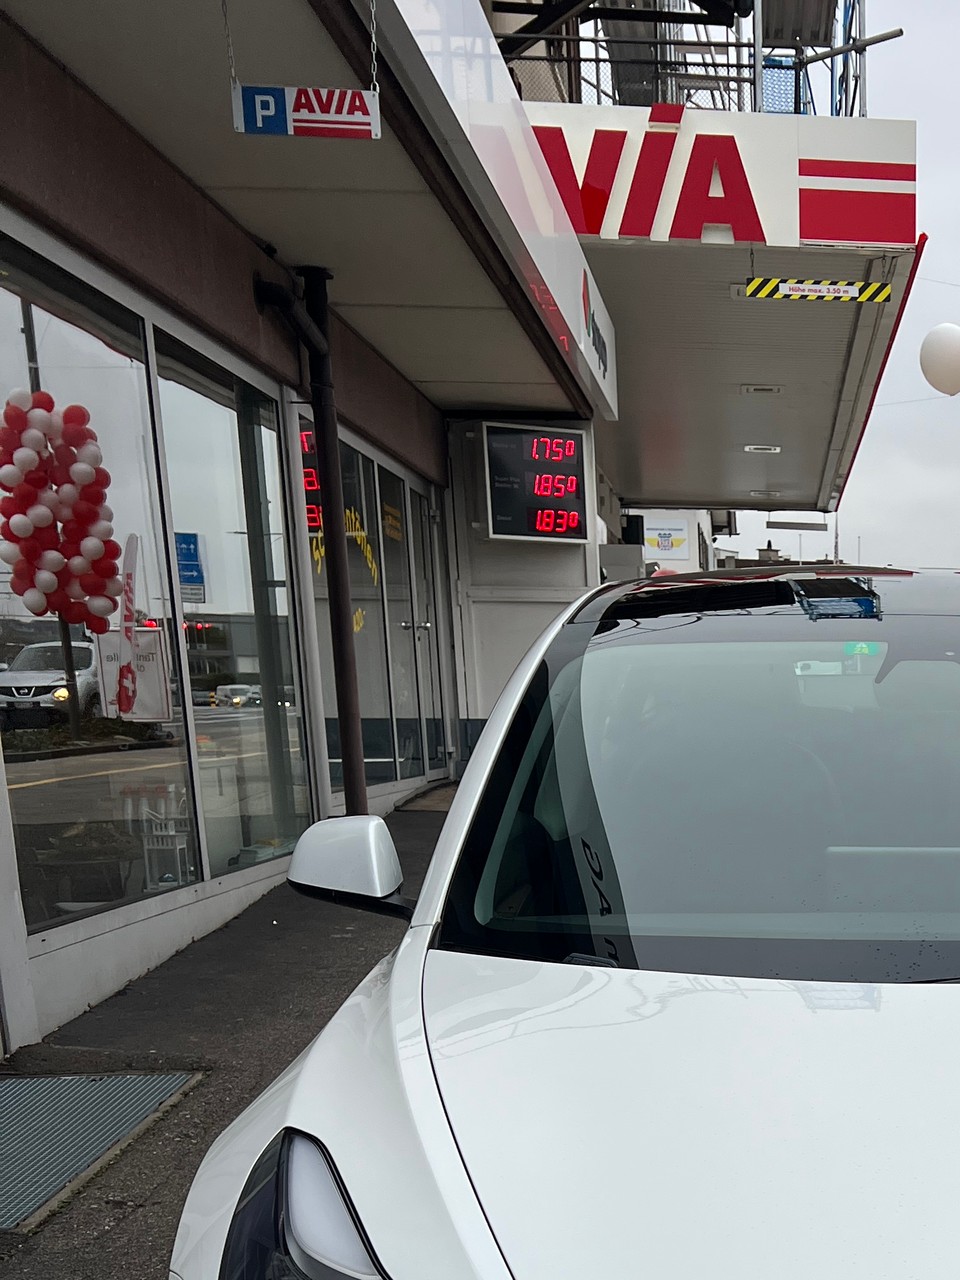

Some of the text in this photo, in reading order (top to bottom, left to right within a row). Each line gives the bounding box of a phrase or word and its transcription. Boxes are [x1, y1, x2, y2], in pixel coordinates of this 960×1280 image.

[254, 87, 370, 128] P AVIA
[531, 103, 767, 245] VIA
[826, 287, 841, 295] 3.50
